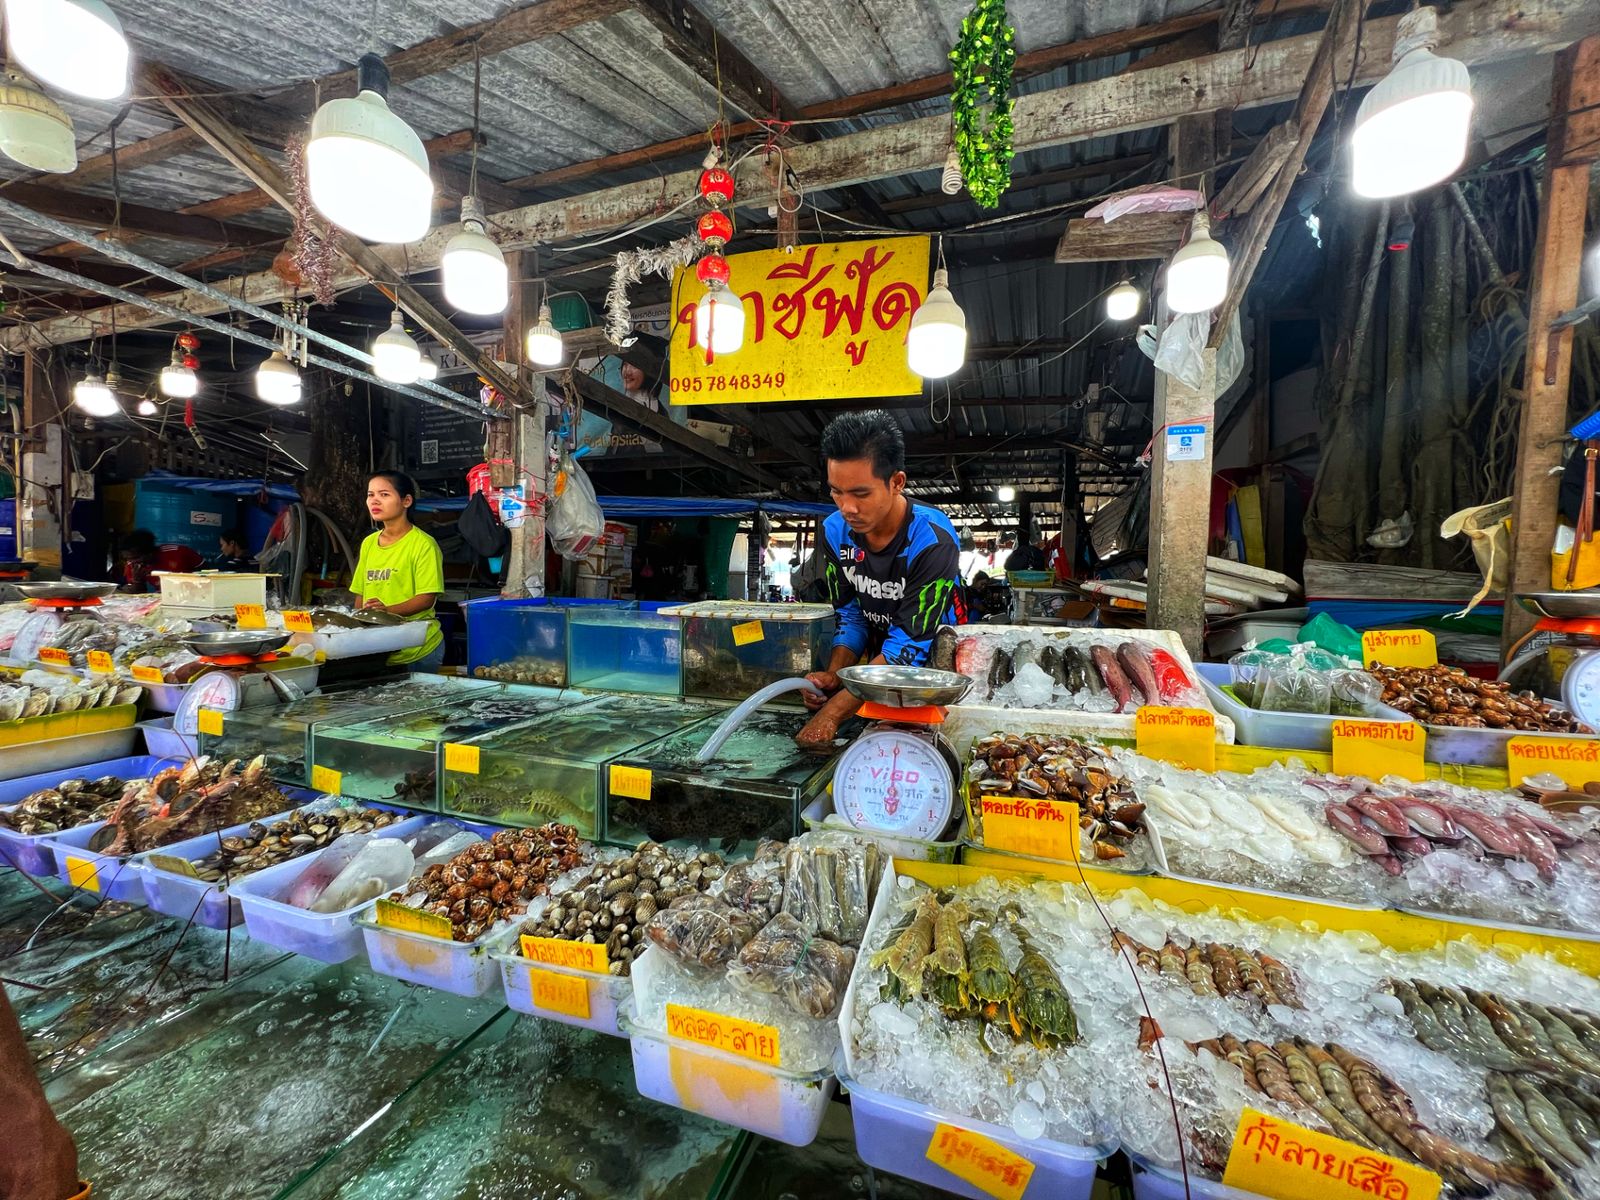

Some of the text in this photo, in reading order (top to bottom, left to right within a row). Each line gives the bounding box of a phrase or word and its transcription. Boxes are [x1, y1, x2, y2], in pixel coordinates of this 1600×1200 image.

[1365, 632, 1421, 652] ปูม้าตาย
[1138, 709, 1214, 727] ปลาหมึกหอม
[1334, 721, 1415, 741] ปลาหมึกไข่
[983, 800, 1064, 821] หอยชักตีน
[1243, 1117, 1409, 1200] กุ้งลายเสือ
